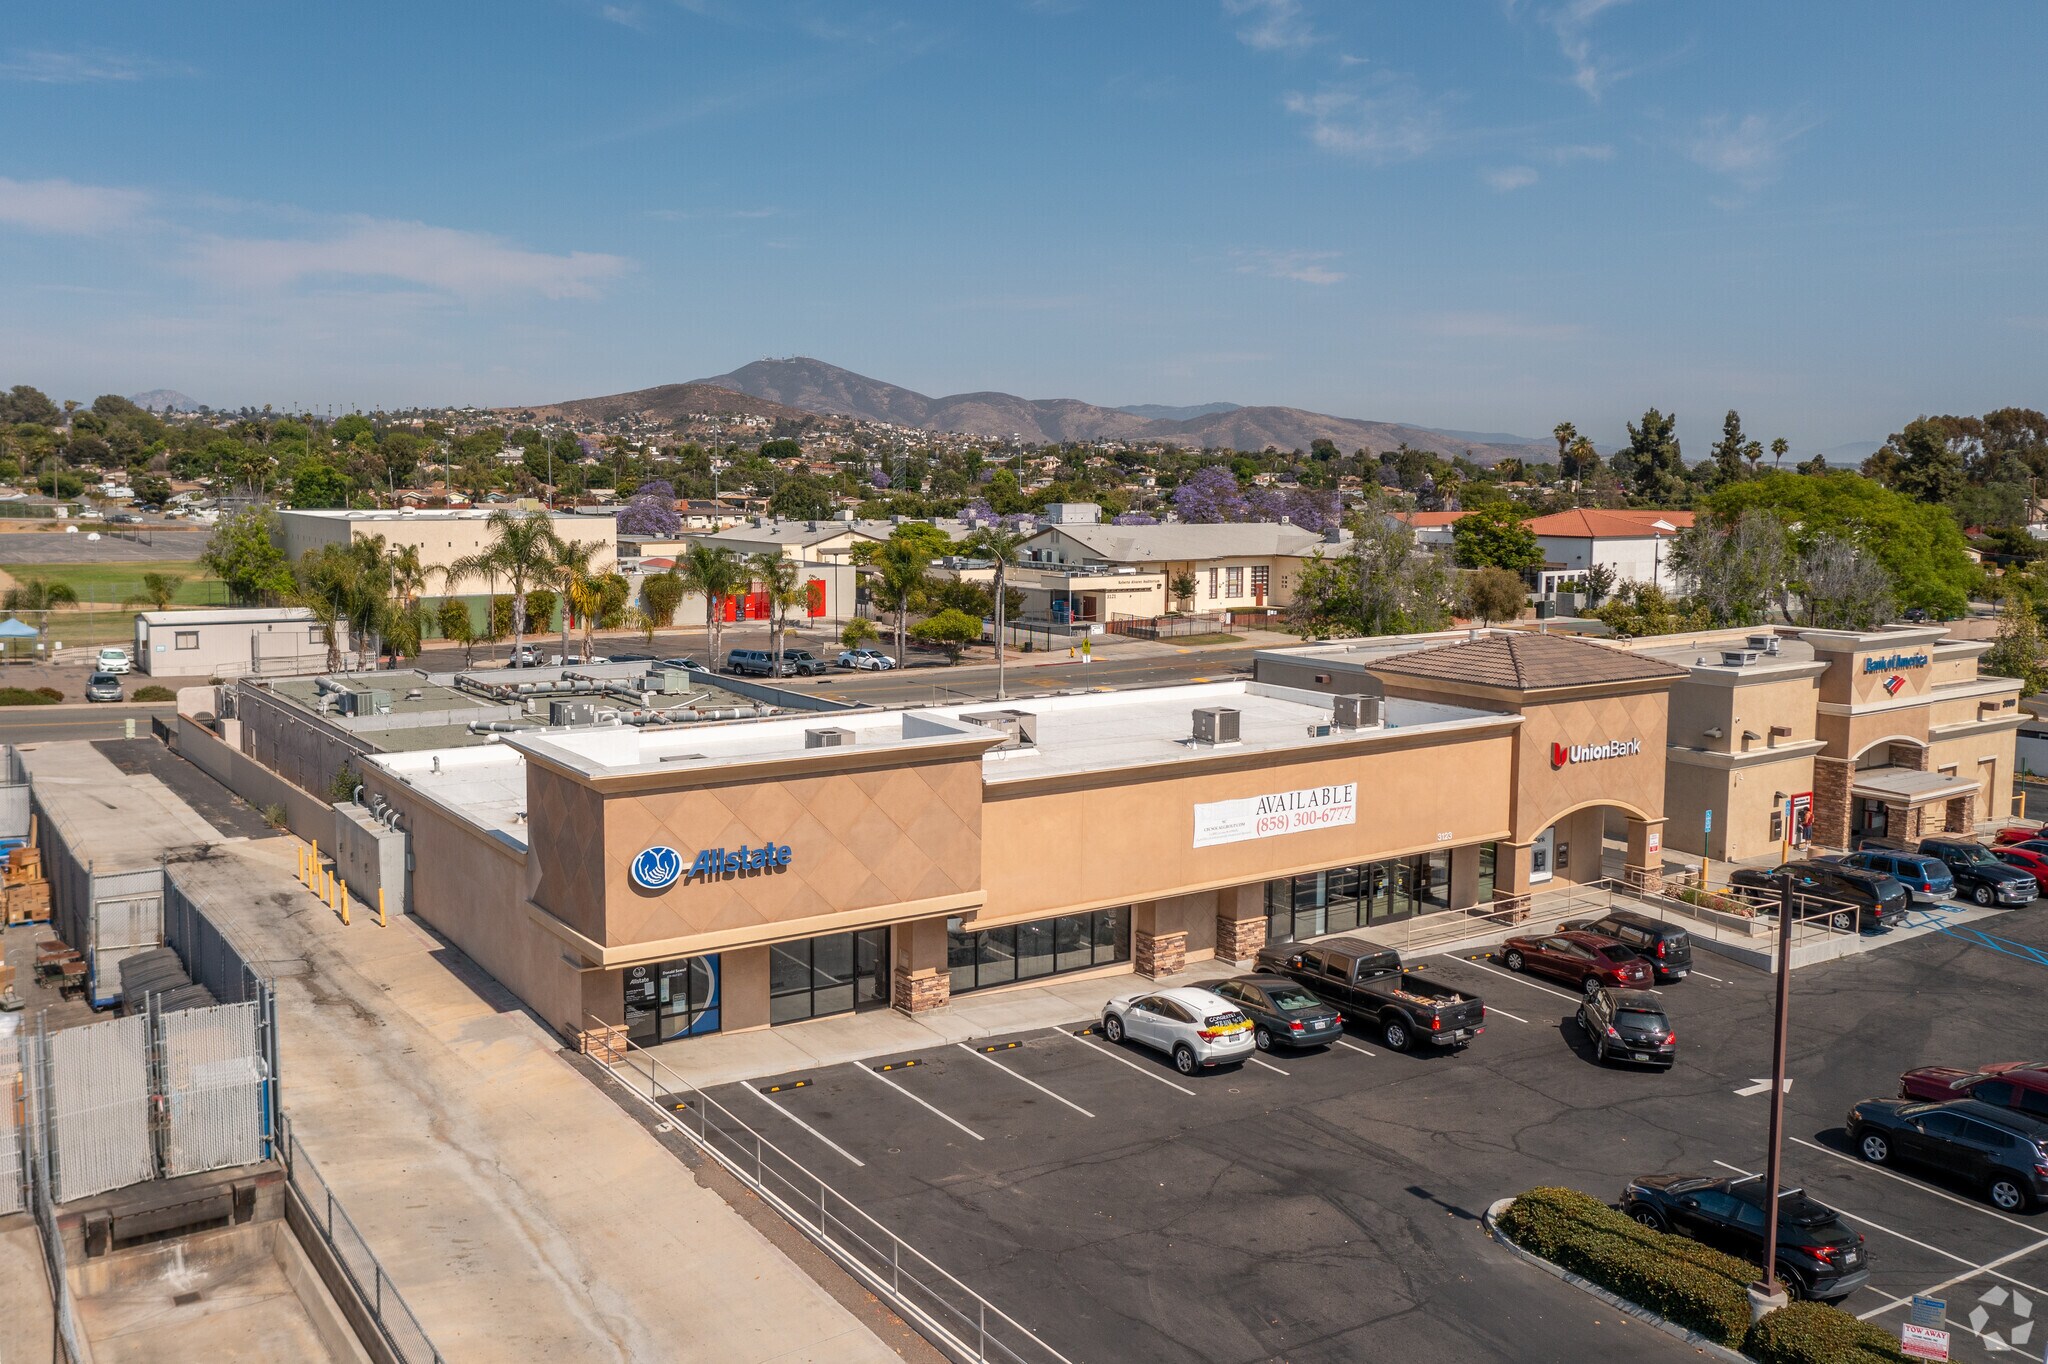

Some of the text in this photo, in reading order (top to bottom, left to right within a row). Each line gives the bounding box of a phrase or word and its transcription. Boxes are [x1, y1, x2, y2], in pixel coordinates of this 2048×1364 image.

[1866, 653, 1928, 671] Bank of America
[1570, 738, 1641, 762] UnionBank
[1256, 785, 1353, 815] AVAILABLE
[1256, 805, 1352, 835] (858) 300-6777
[1437, 832, 1453, 841] 3123
[688, 842, 792, 877] Allstate
[629, 977, 650, 985] Allstate
[1905, 1325, 1946, 1339] TOW AWAY
